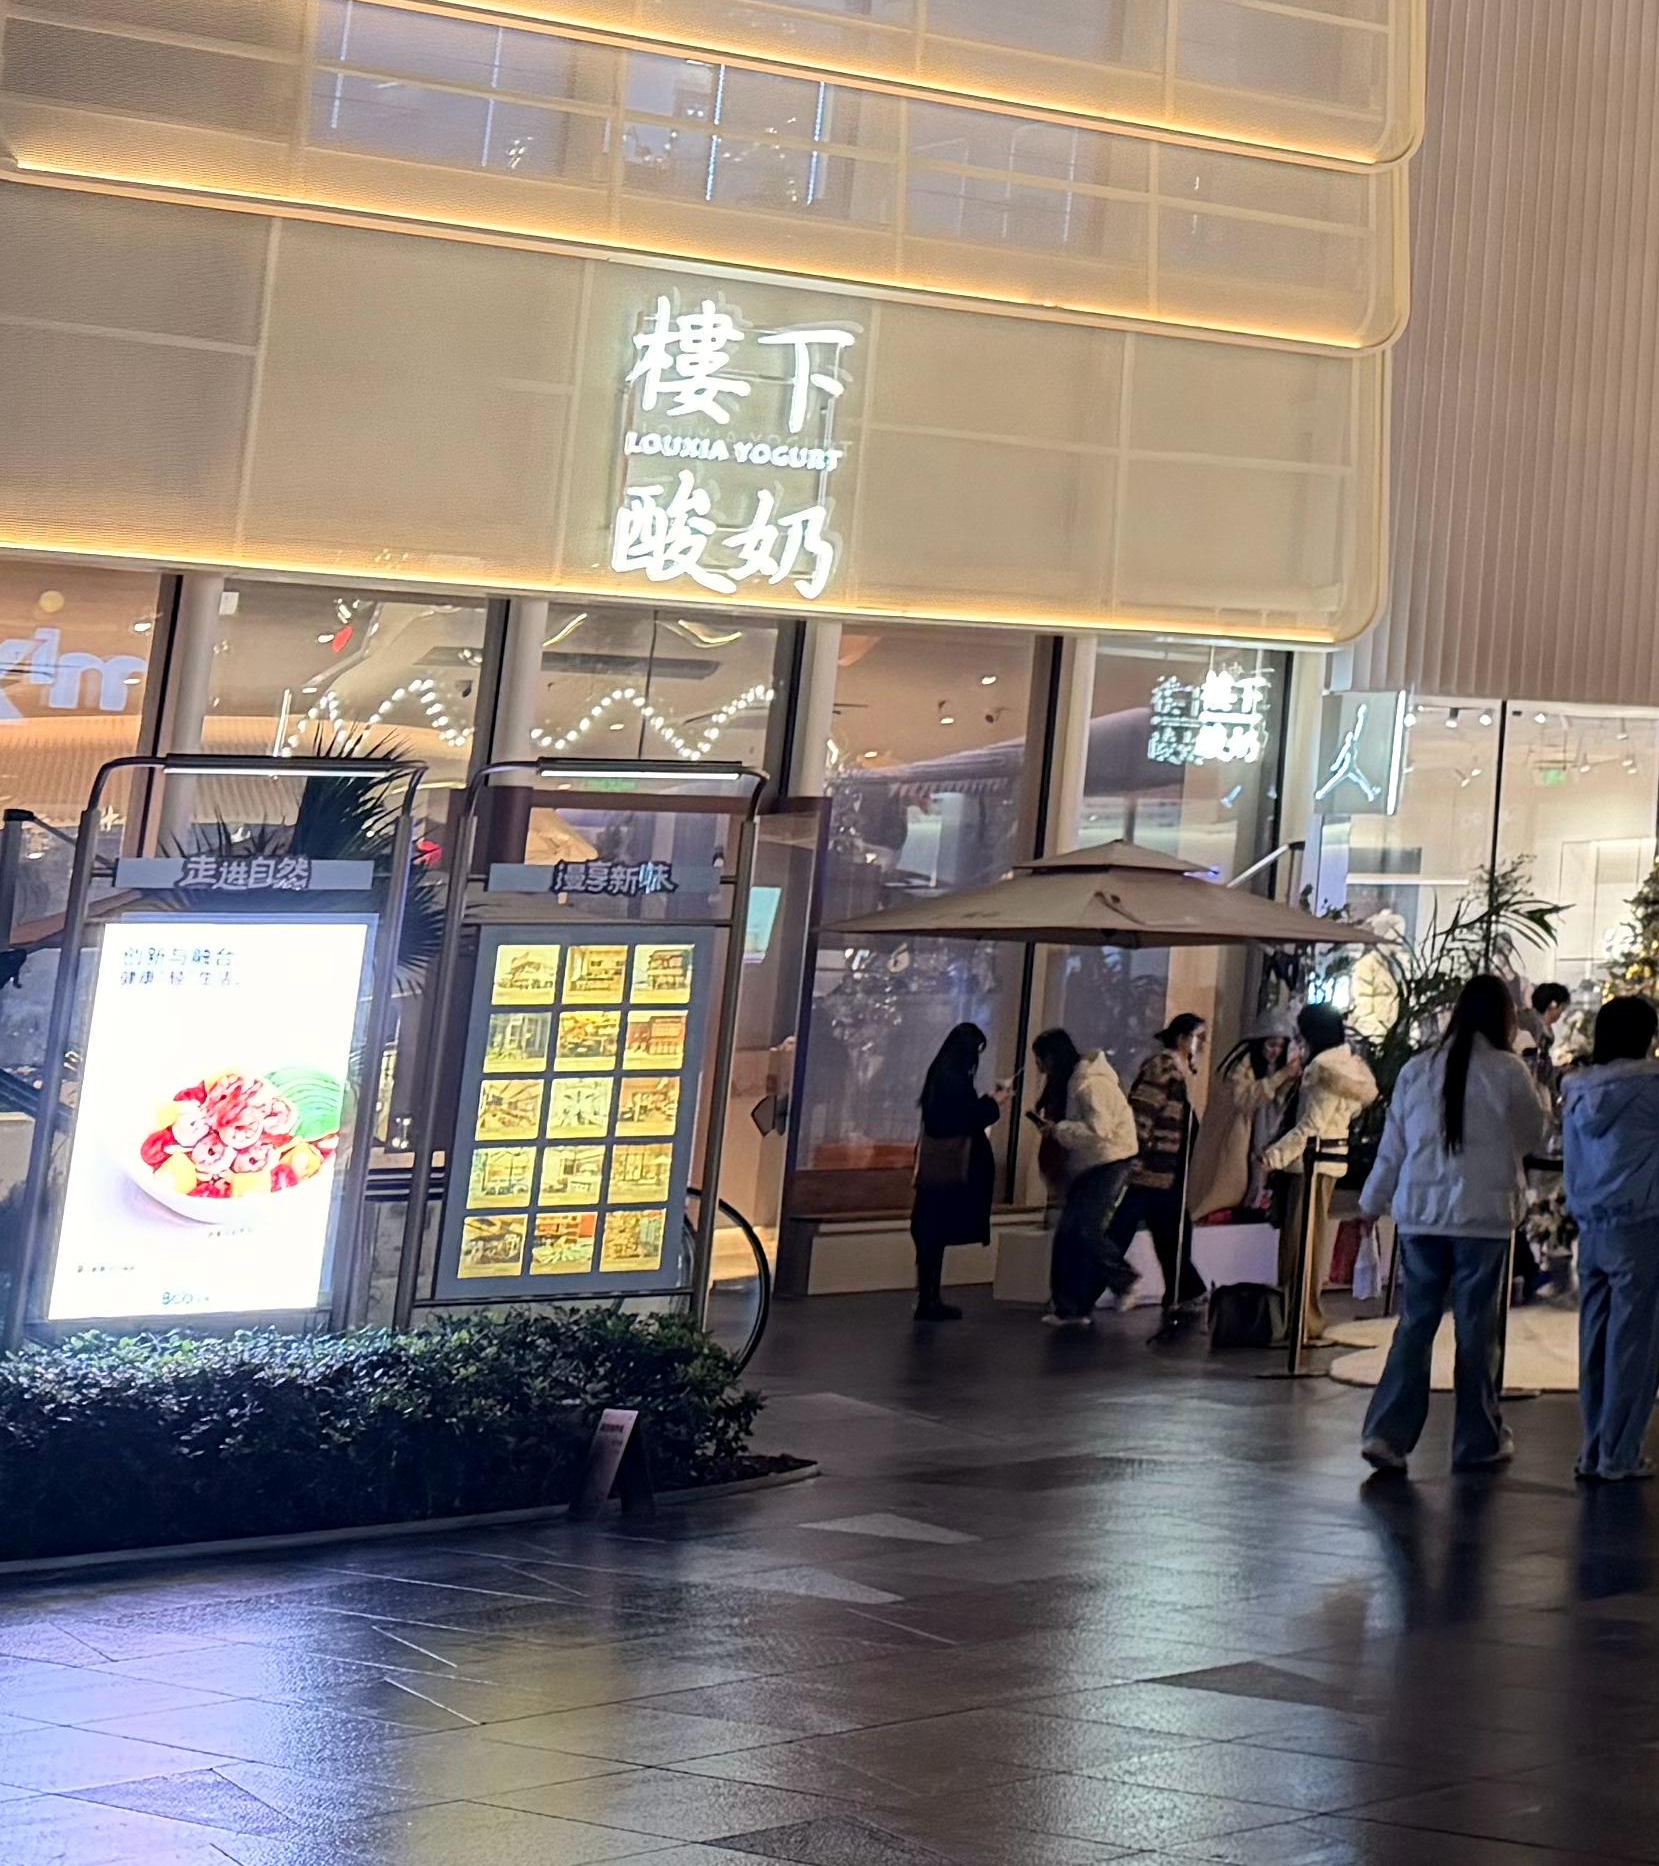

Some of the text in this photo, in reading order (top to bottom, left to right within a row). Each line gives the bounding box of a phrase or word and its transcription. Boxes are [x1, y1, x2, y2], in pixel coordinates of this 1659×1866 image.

[625, 295, 855, 433] 樓下
[624, 432, 843, 472] LOUXIA YOGURT
[611, 469, 834, 599] 酸奶
[178, 855, 310, 891] 走进自然
